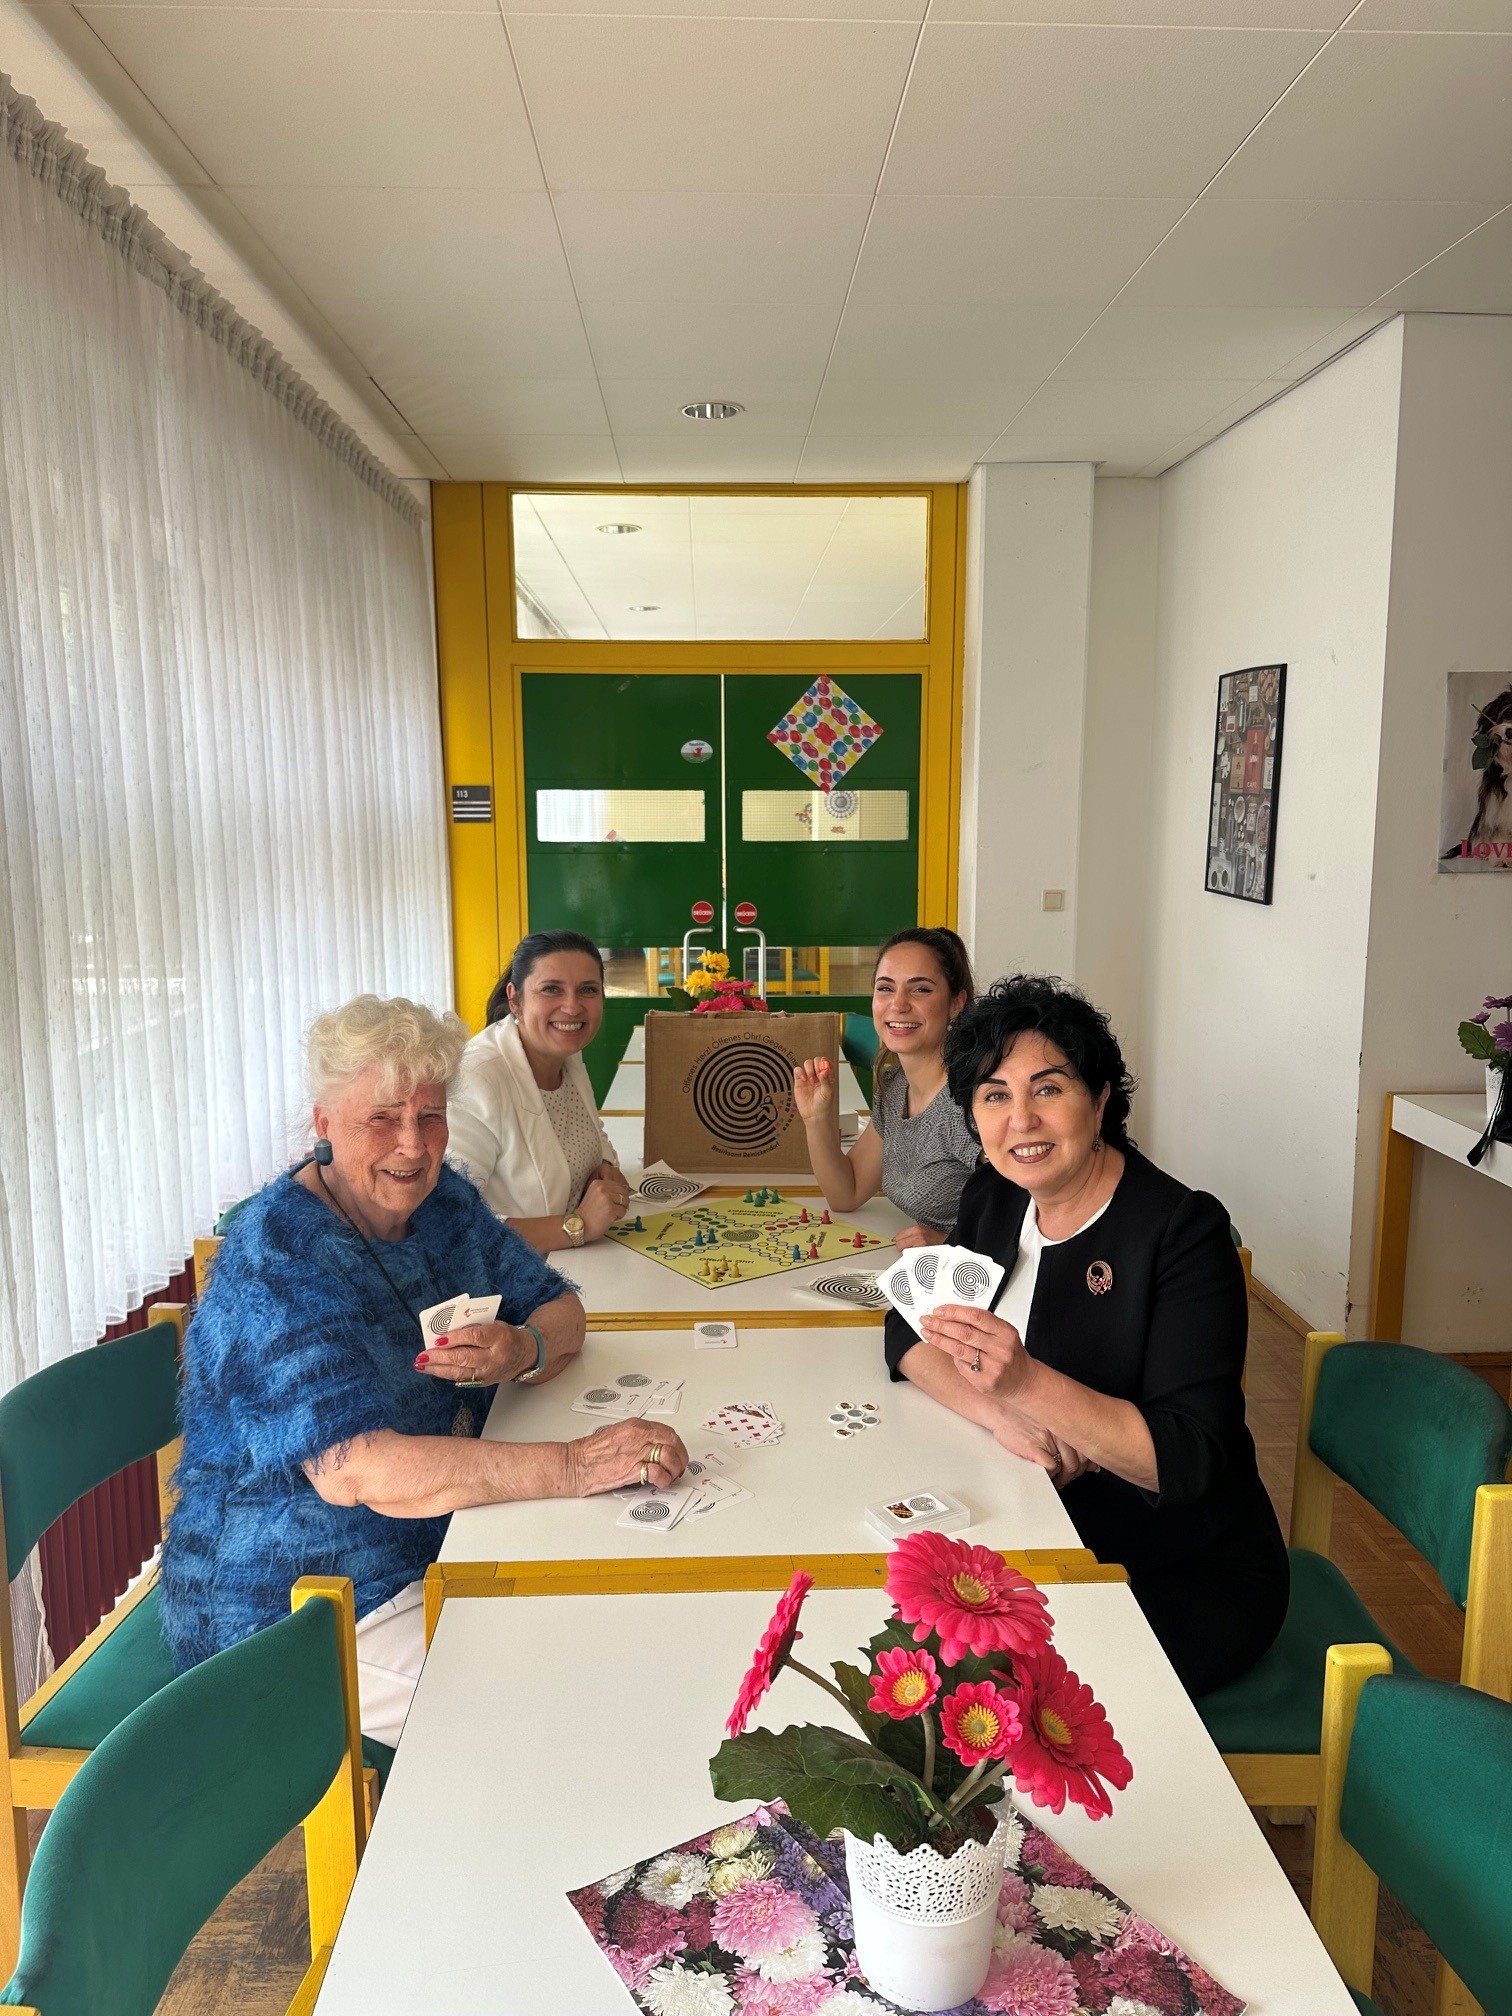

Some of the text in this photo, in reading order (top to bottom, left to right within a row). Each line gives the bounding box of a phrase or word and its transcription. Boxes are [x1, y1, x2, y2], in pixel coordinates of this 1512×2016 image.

[456, 790, 468, 798] 113
[682, 1064, 698, 1093] Offenes
[694, 1046, 713, 1065] Herz!
[712, 1034, 742, 1049] Offenes
[743, 1031, 762, 1041] Ohr!
[762, 1035, 787, 1054] Gegen
[711, 1141, 780, 1158] Bezirksamt Reinickendorf
